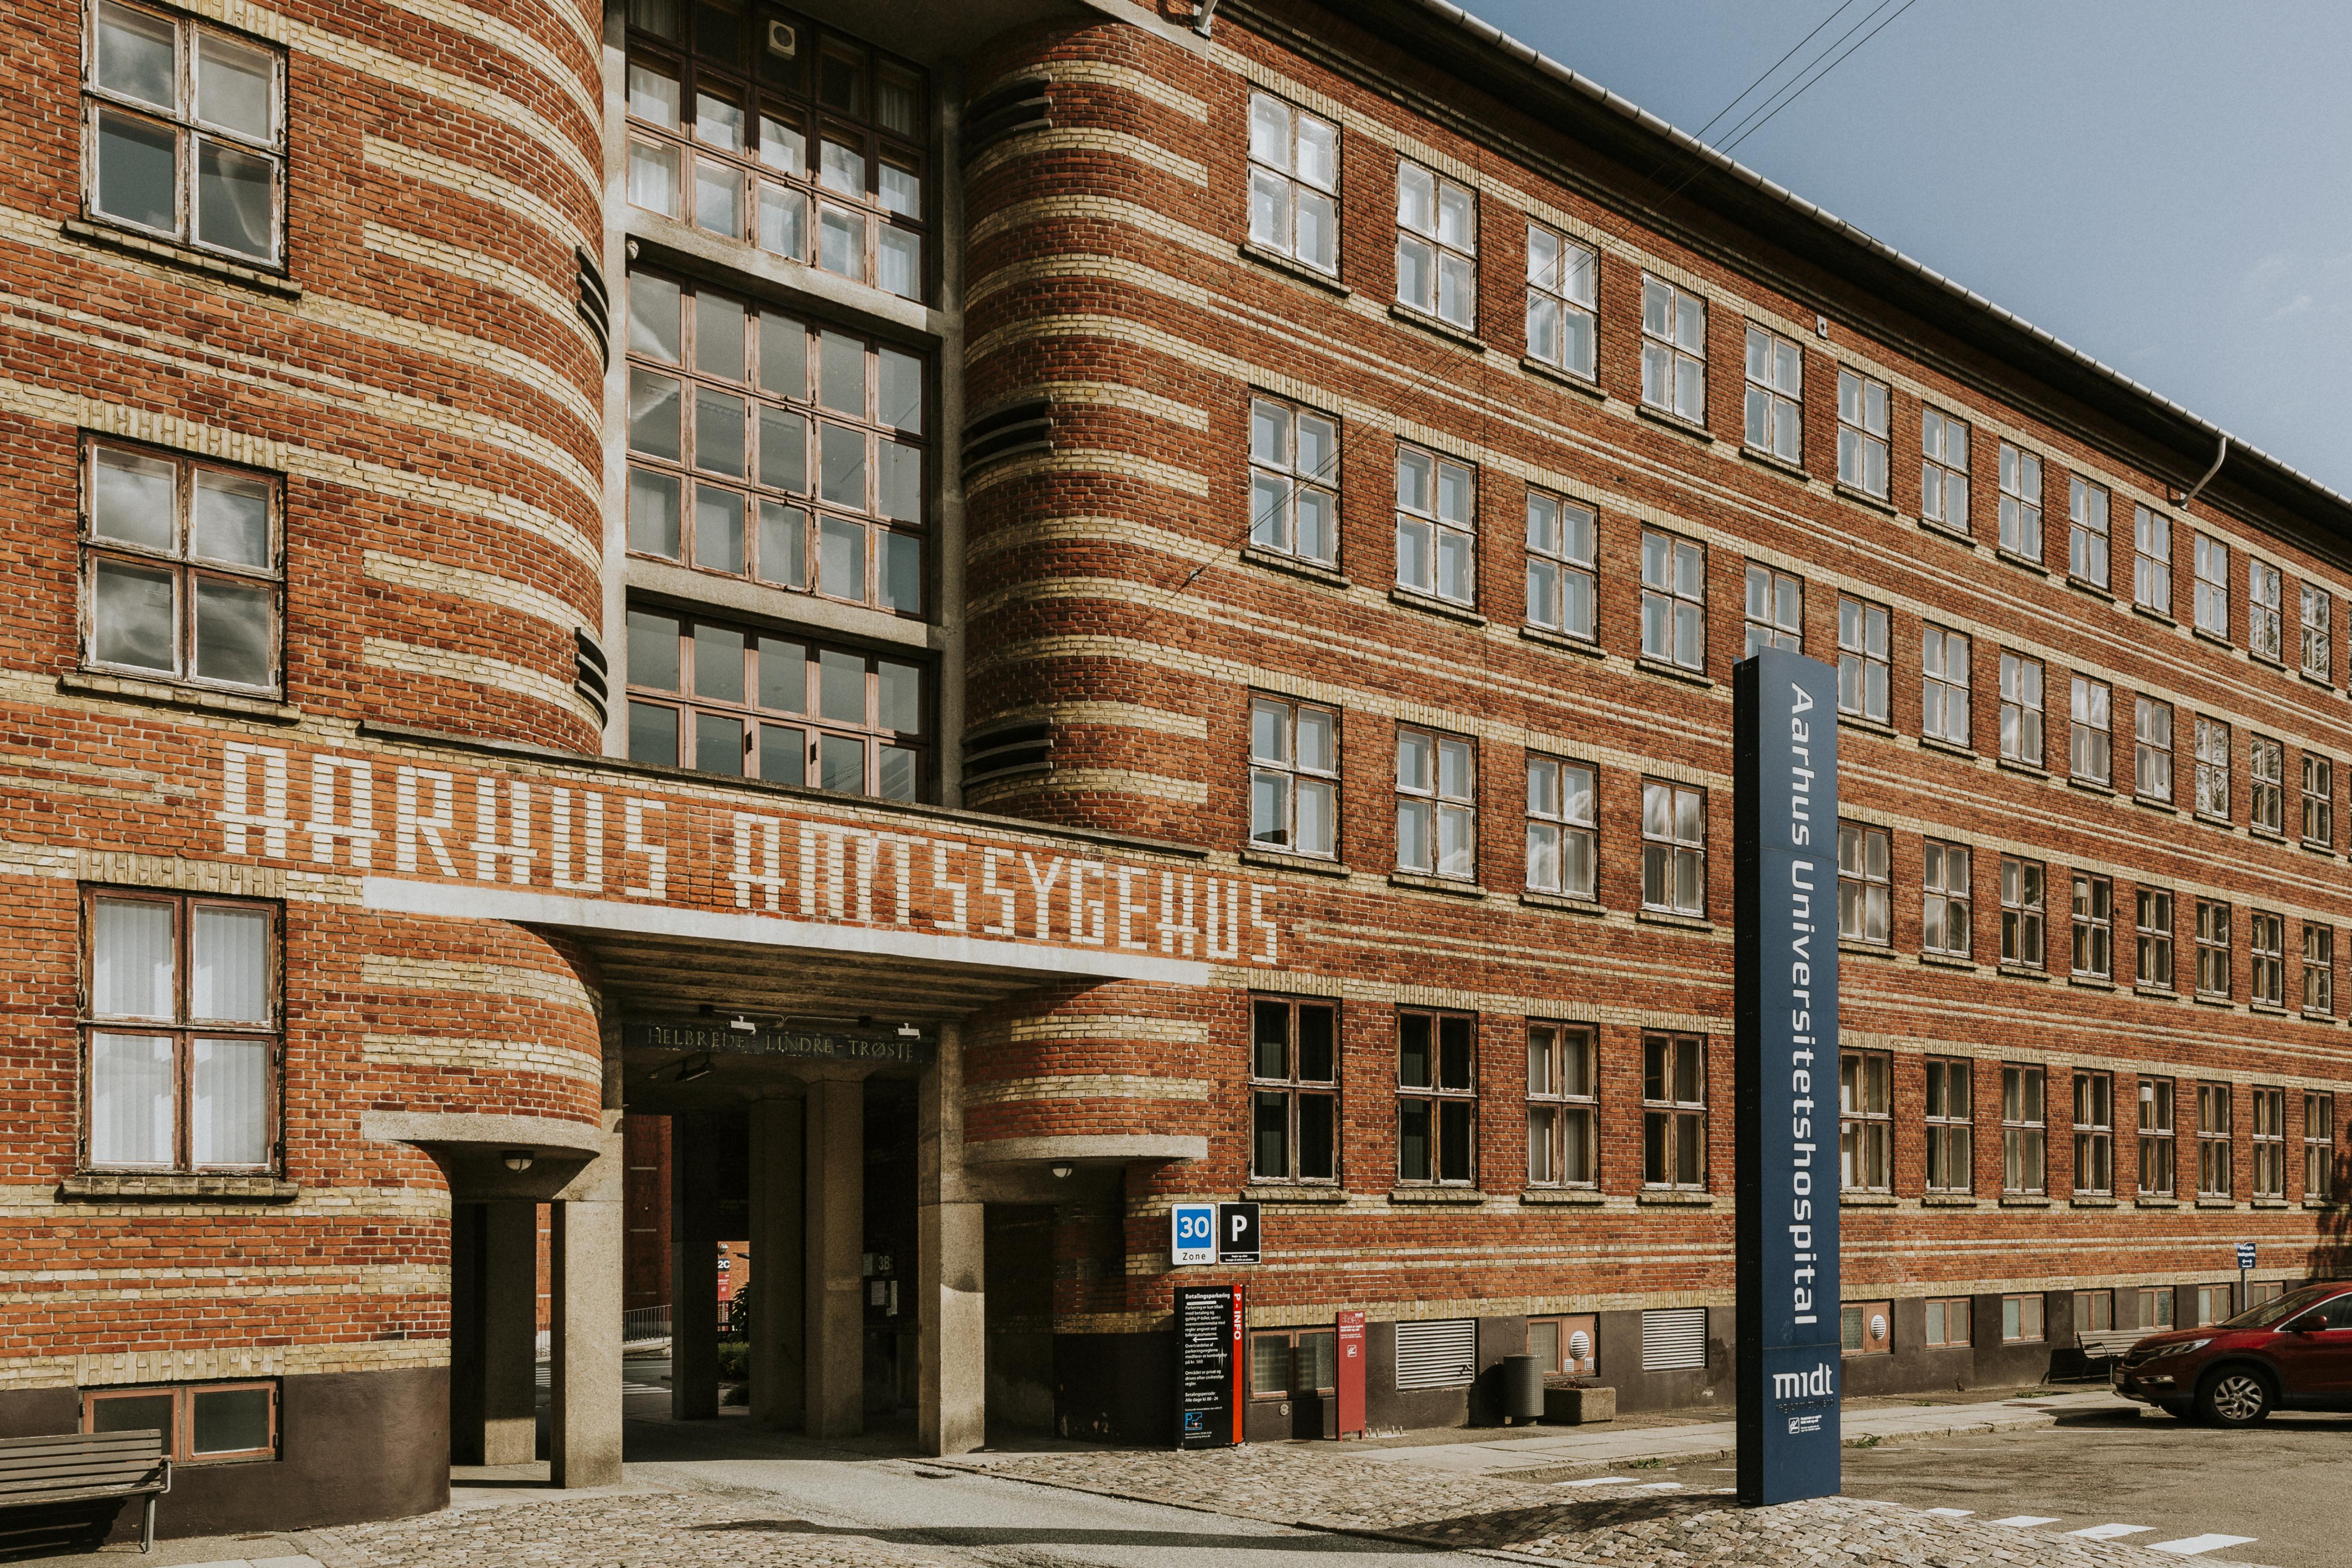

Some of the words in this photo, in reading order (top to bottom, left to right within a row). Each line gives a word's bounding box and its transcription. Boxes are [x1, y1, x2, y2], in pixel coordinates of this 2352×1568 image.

[1792, 681, 1815, 846] Aarhus
[214, 741, 667, 898] AARHUS
[648, 1028, 745, 1048] HELBREDE
[766, 1035, 831, 1053] LINDRE
[848, 1040, 913, 1060] TRØSTE
[1789, 859, 1817, 1324] Universitetshospital
[1180, 1216, 1209, 1238] 30
[1232, 1215, 1247, 1241] P
[878, 1256, 890, 1271] 3B
[1773, 1363, 1833, 1399] midt
